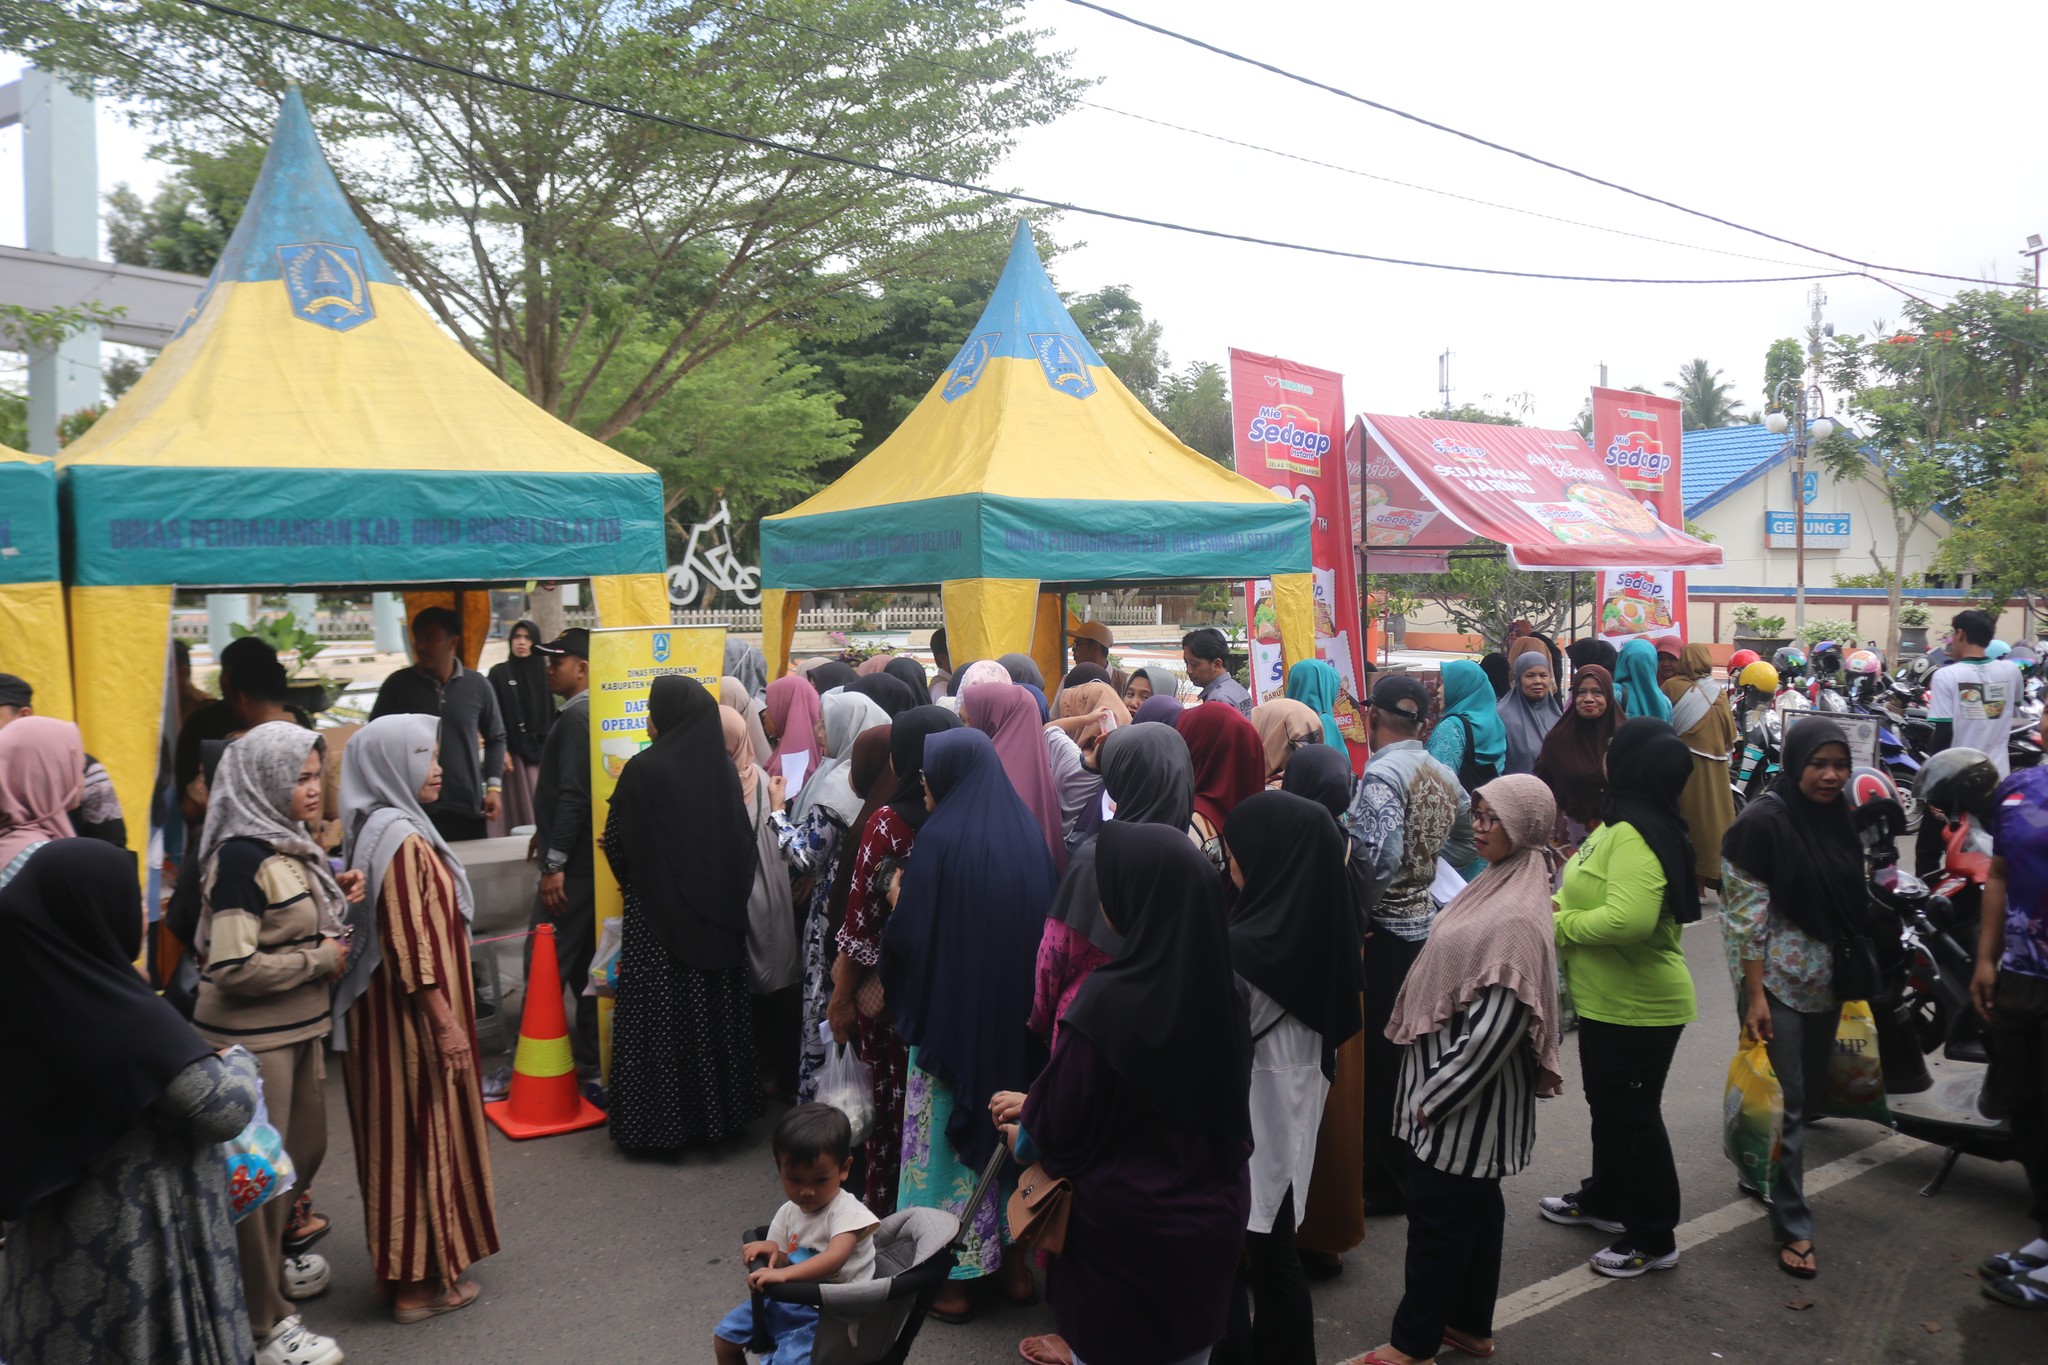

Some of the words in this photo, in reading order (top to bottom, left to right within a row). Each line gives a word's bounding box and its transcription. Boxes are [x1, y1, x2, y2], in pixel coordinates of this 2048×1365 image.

[1260, 407, 1281, 419] Mie
[1249, 420, 1329, 456] Sedaap
[1615, 435, 1630, 445] Mie
[1290, 448, 1315, 460] instant
[1605, 446, 1670, 474] Sedaap
[1317, 517, 1328, 531] TH
[1773, 521, 1835, 534] GEUNG
[1839, 522, 1849, 534] 2
[1617, 574, 1662, 596] Sedaap
[601, 681, 645, 691] KABUPATEN
[1264, 689, 1284, 702] BARU!
[625, 700, 650, 713] DAF
[602, 717, 648, 731] OPERAS
[1335, 714, 1352, 724] RENG
